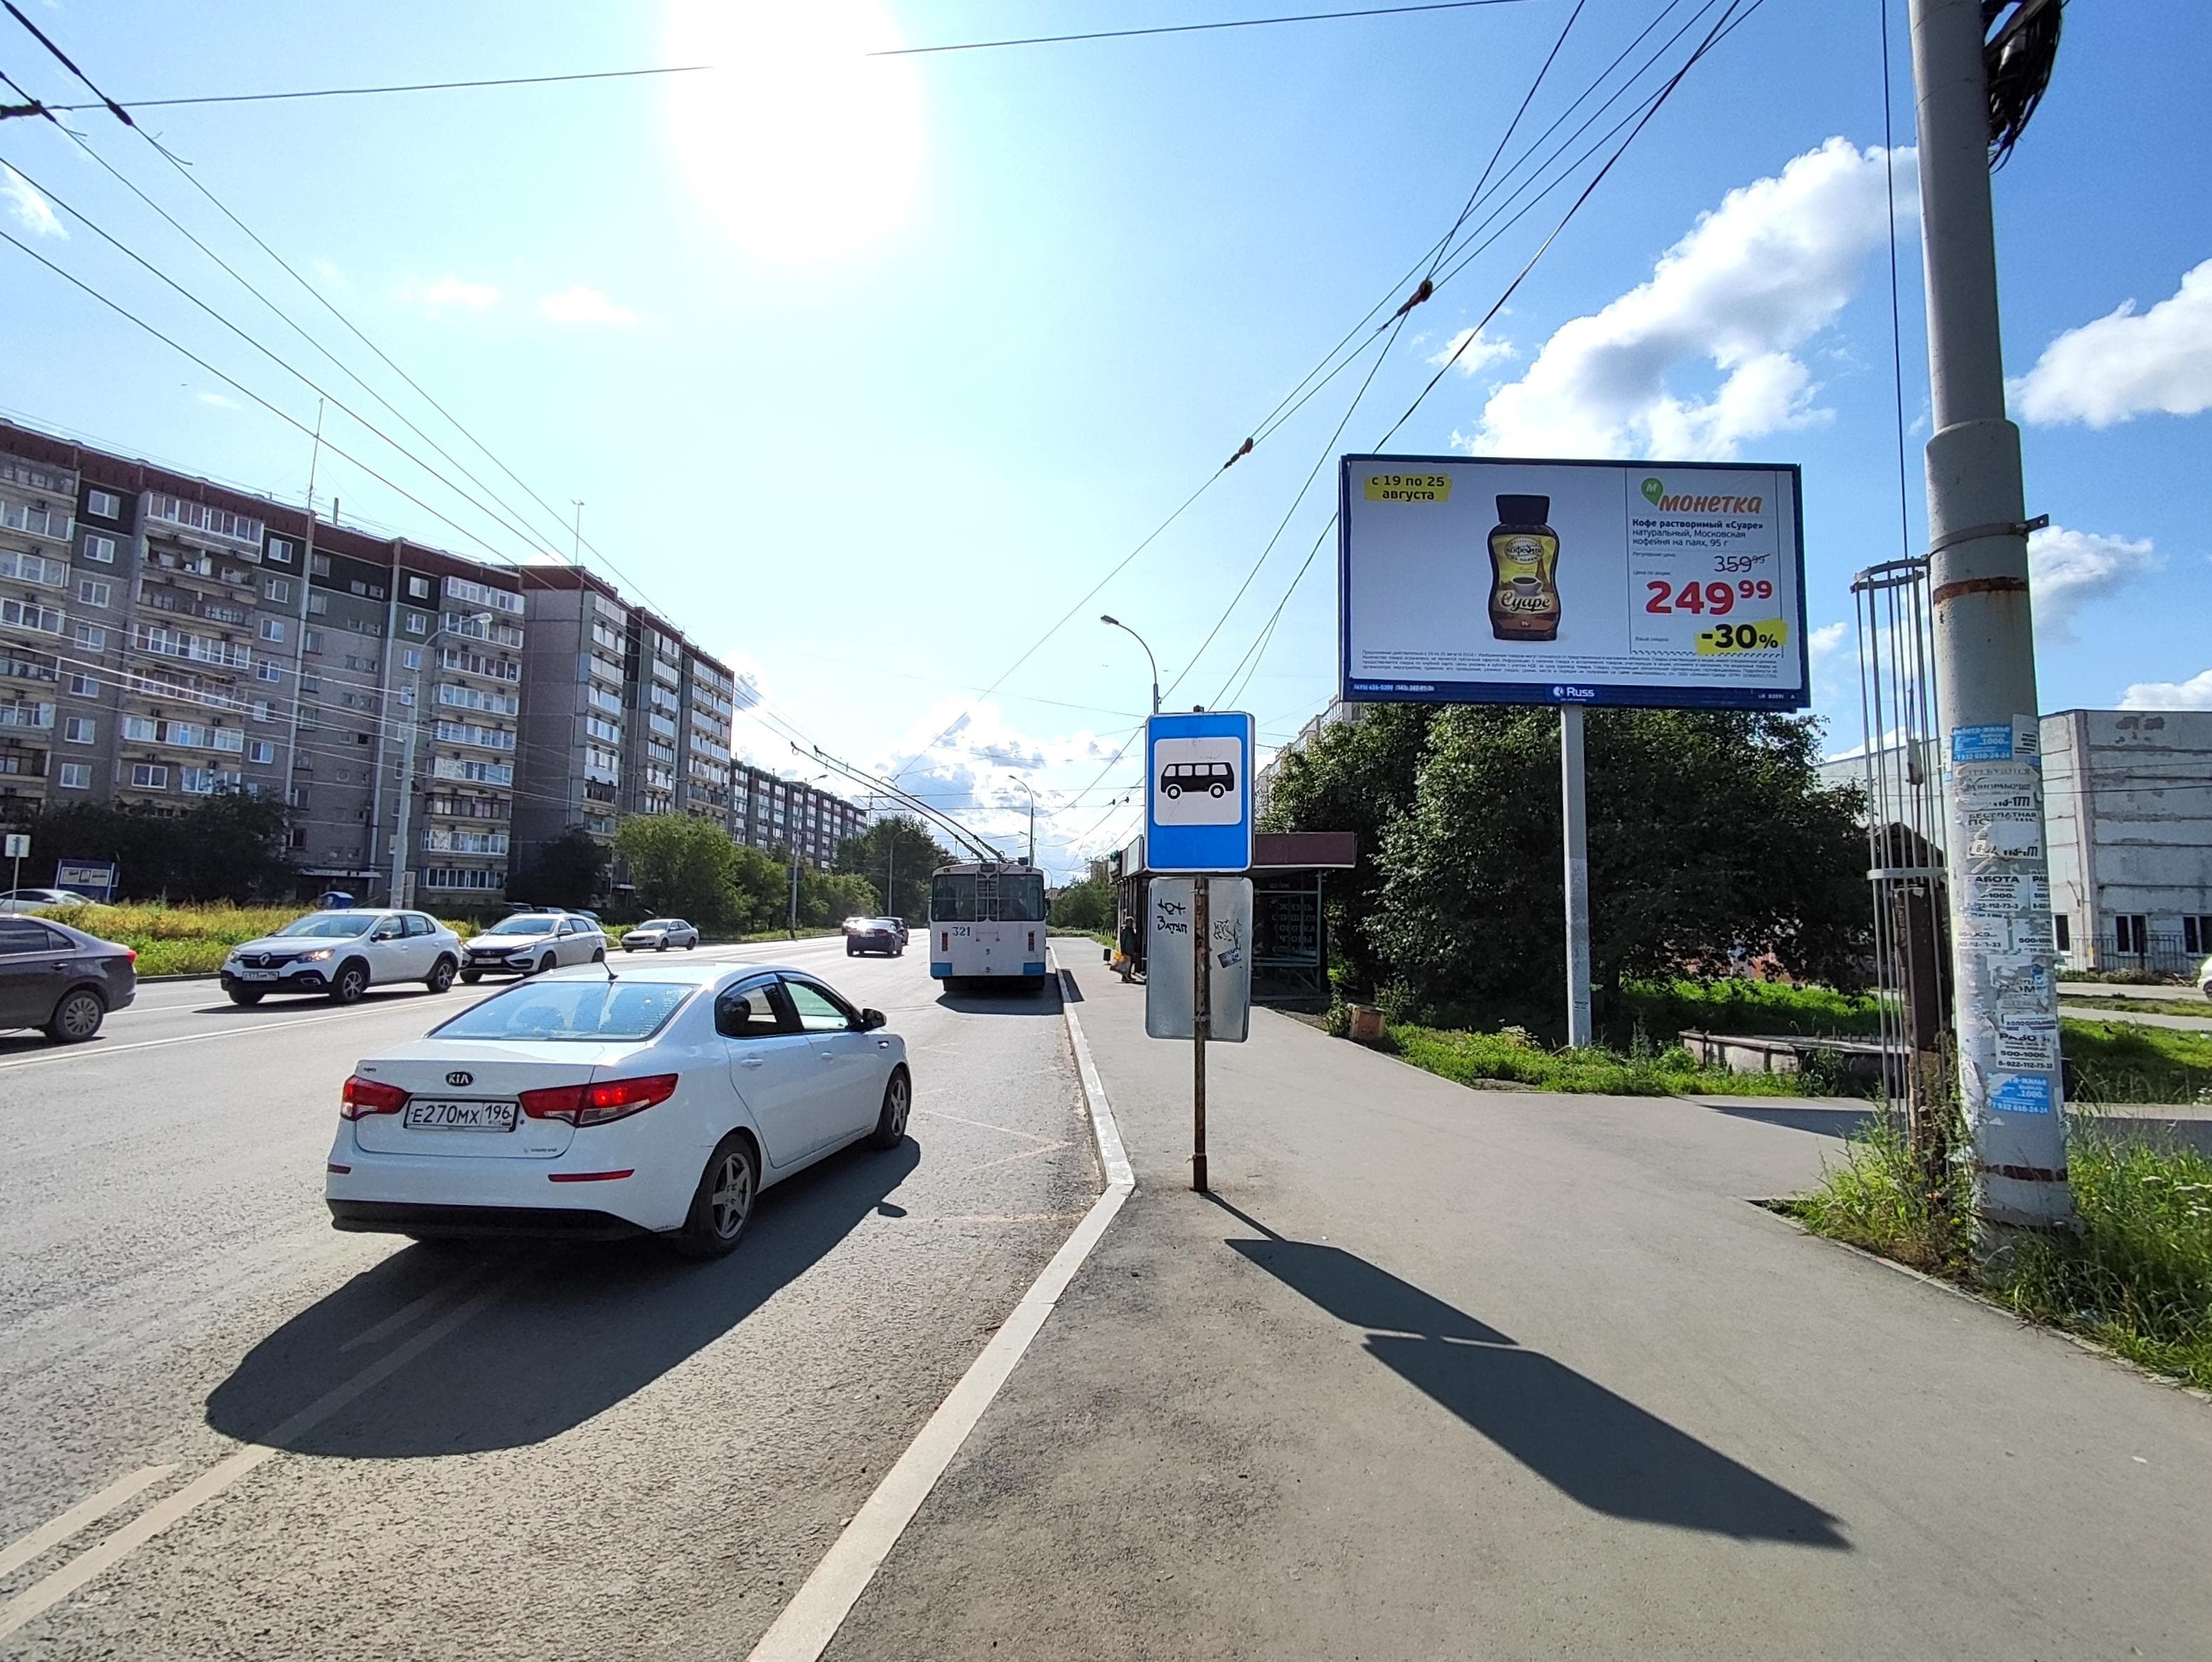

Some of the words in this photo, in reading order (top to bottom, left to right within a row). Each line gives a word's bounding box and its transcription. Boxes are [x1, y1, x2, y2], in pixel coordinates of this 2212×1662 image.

[1372, 477, 1379, 485] с
[1384, 475, 1401, 486] 19
[1405, 478, 1422, 486] по
[1427, 476, 1445, 487] 25
[1382, 490, 1434, 502] августа
[1633, 519, 1657, 528] Кофе
[1659, 520, 1722, 529] растворимый
[1725, 521, 1763, 530] «Суаре»
[1633, 529, 1692, 539] натуральный,
[1694, 530, 1746, 539] Московская
[1633, 539, 1670, 548] кофейня
[1501, 591, 1550, 612] Суаре
[1701, 624, 1779, 649] -30%
[1567, 687, 1595, 697] Russ
[952, 927, 970, 936] 321
[447, 1074, 470, 1084] KIA
